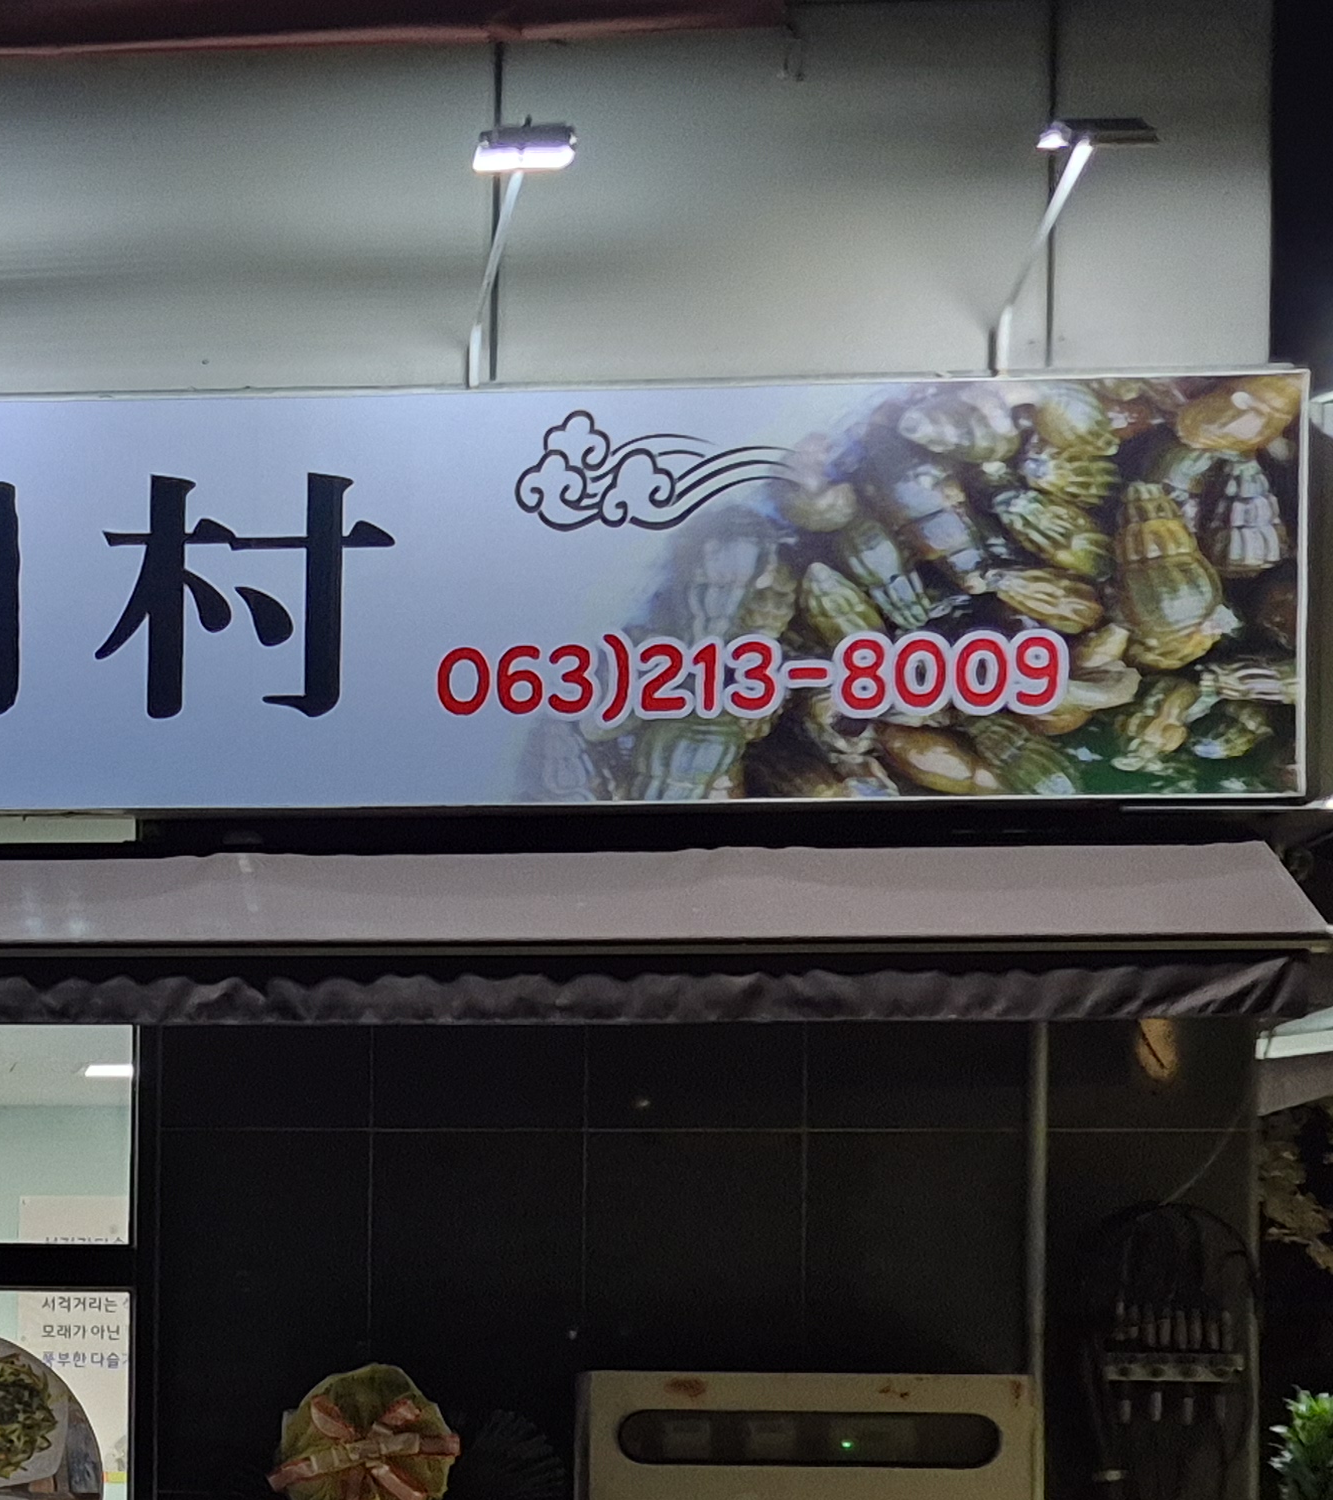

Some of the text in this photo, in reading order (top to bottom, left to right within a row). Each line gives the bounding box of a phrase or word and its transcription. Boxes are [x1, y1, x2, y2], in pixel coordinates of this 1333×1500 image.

[95, 472, 396, 718] 村
[437, 634, 1059, 722] 063)213-8009
[41, 1324, 121, 1341] 모래가 아닌
